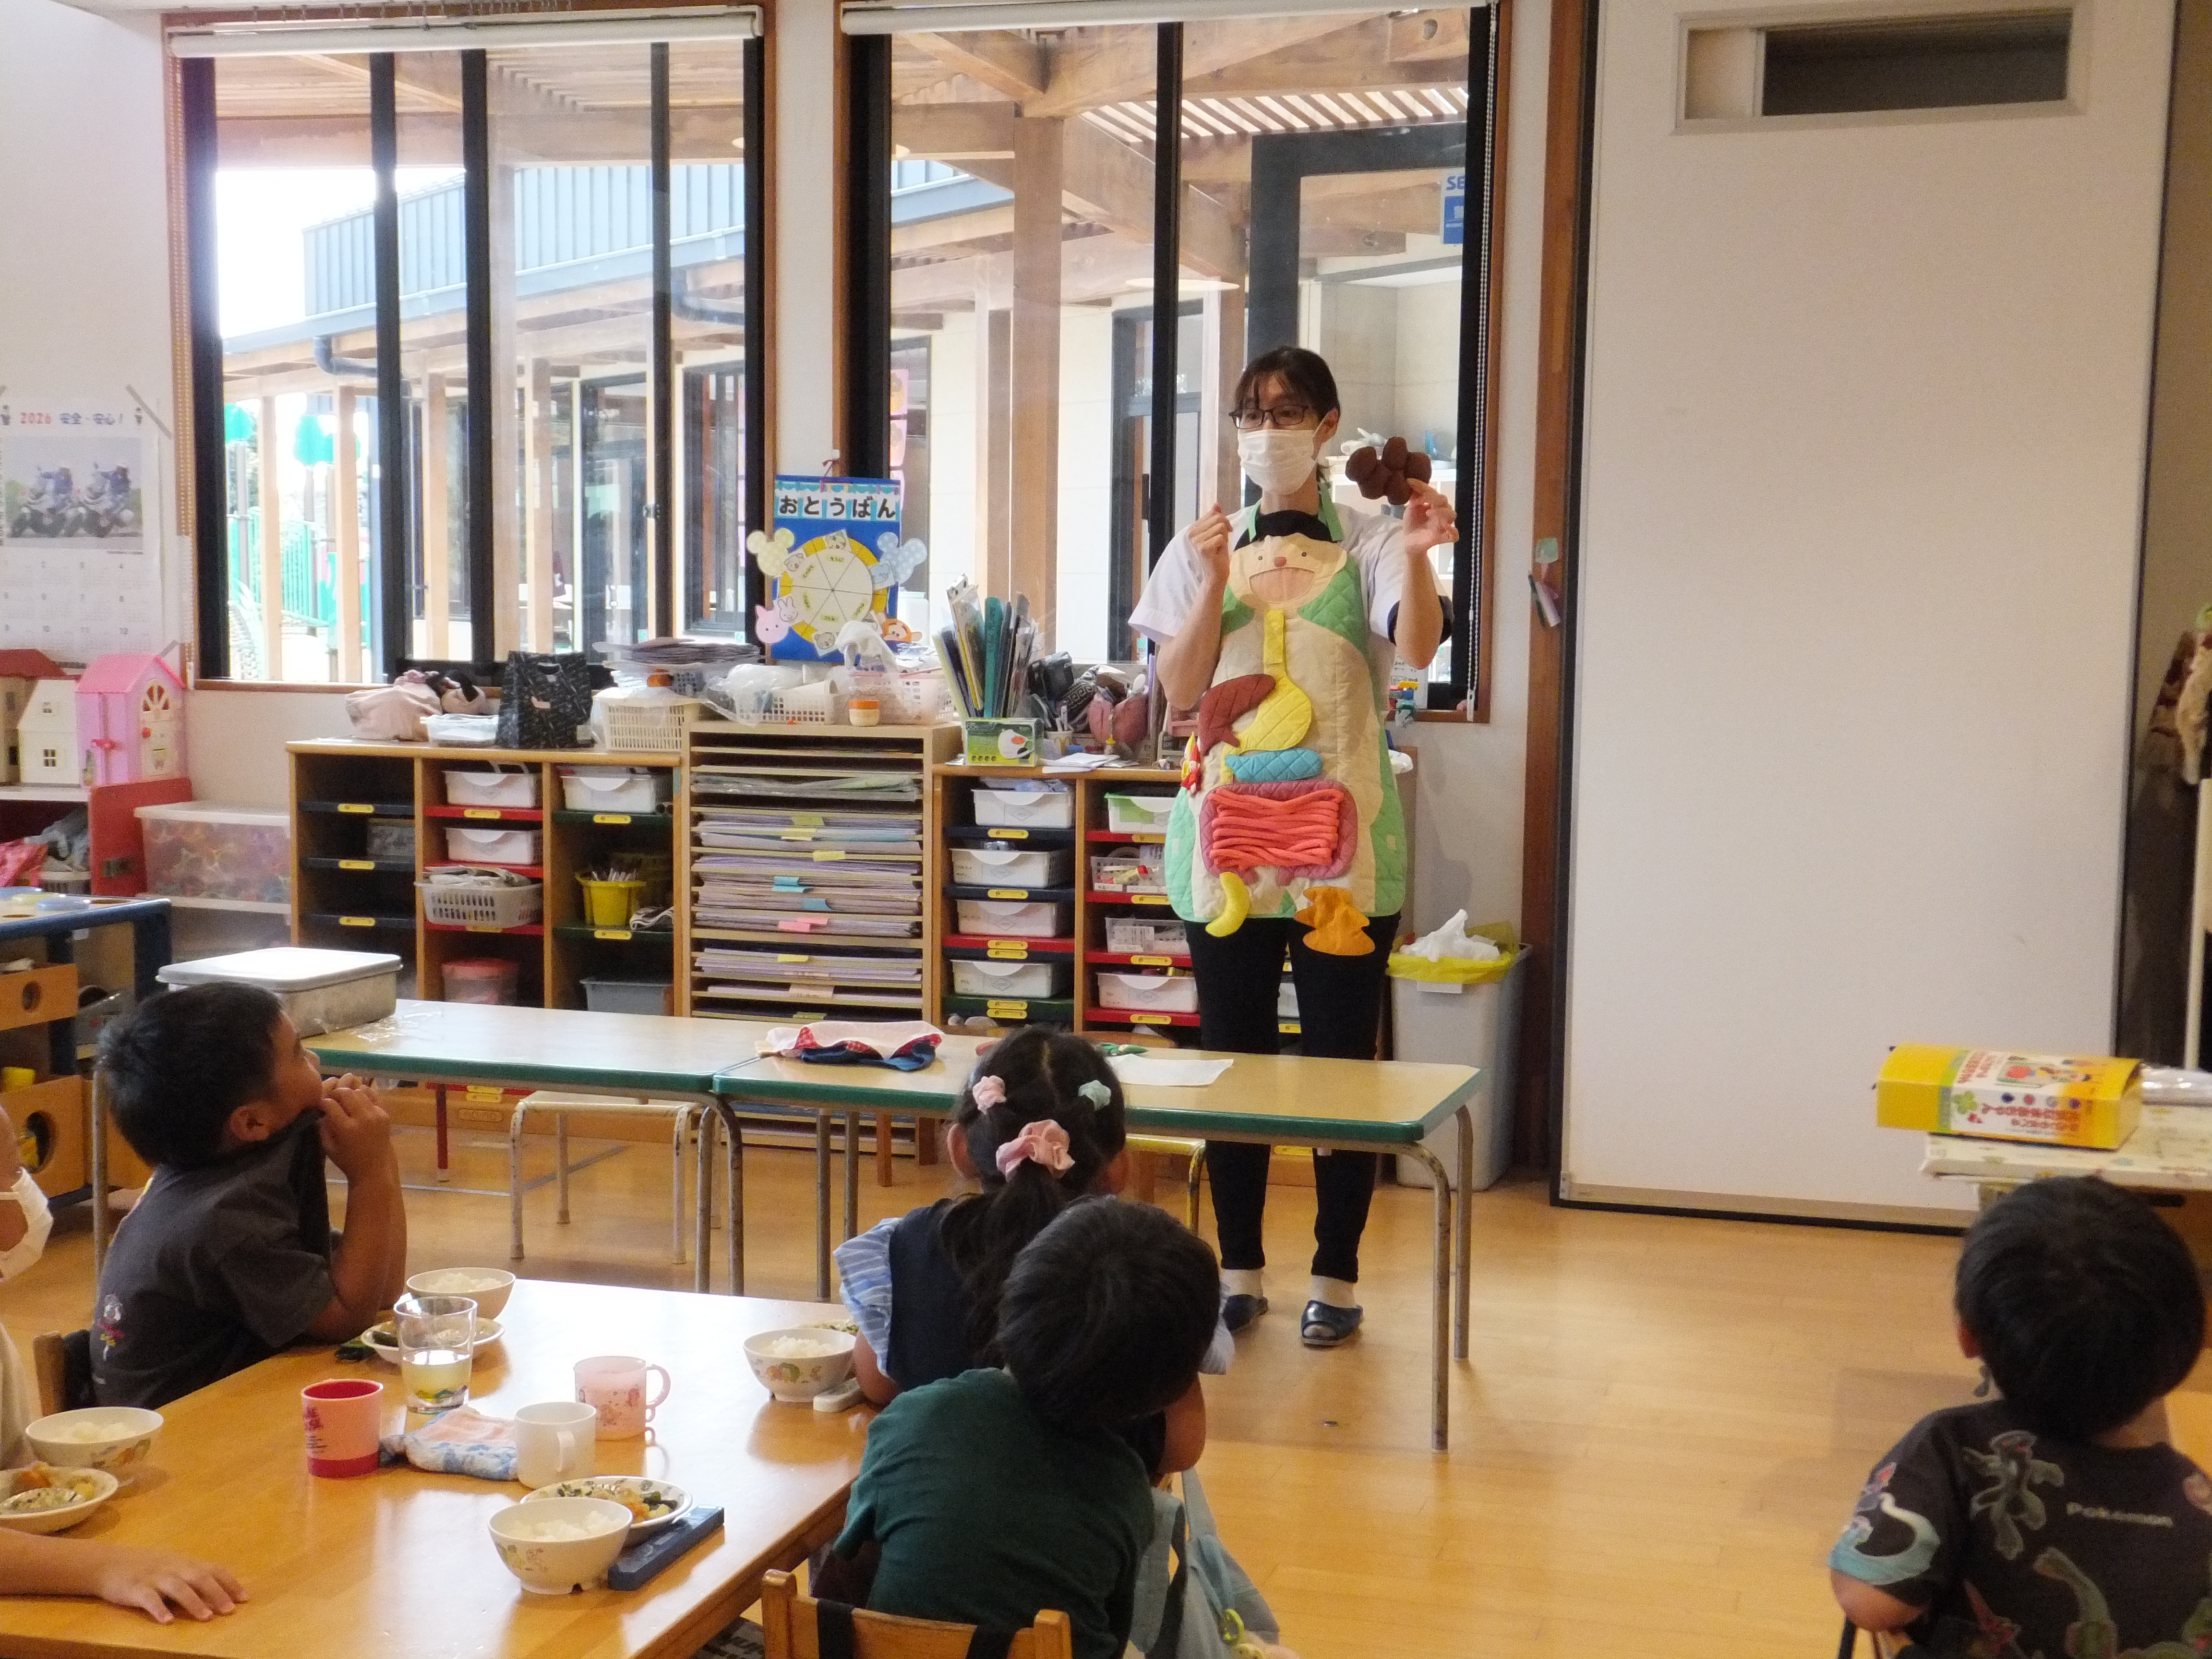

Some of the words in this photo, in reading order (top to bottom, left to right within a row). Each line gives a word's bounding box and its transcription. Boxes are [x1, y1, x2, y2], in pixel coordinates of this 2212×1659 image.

[780, 495, 896, 518] おとうばん
